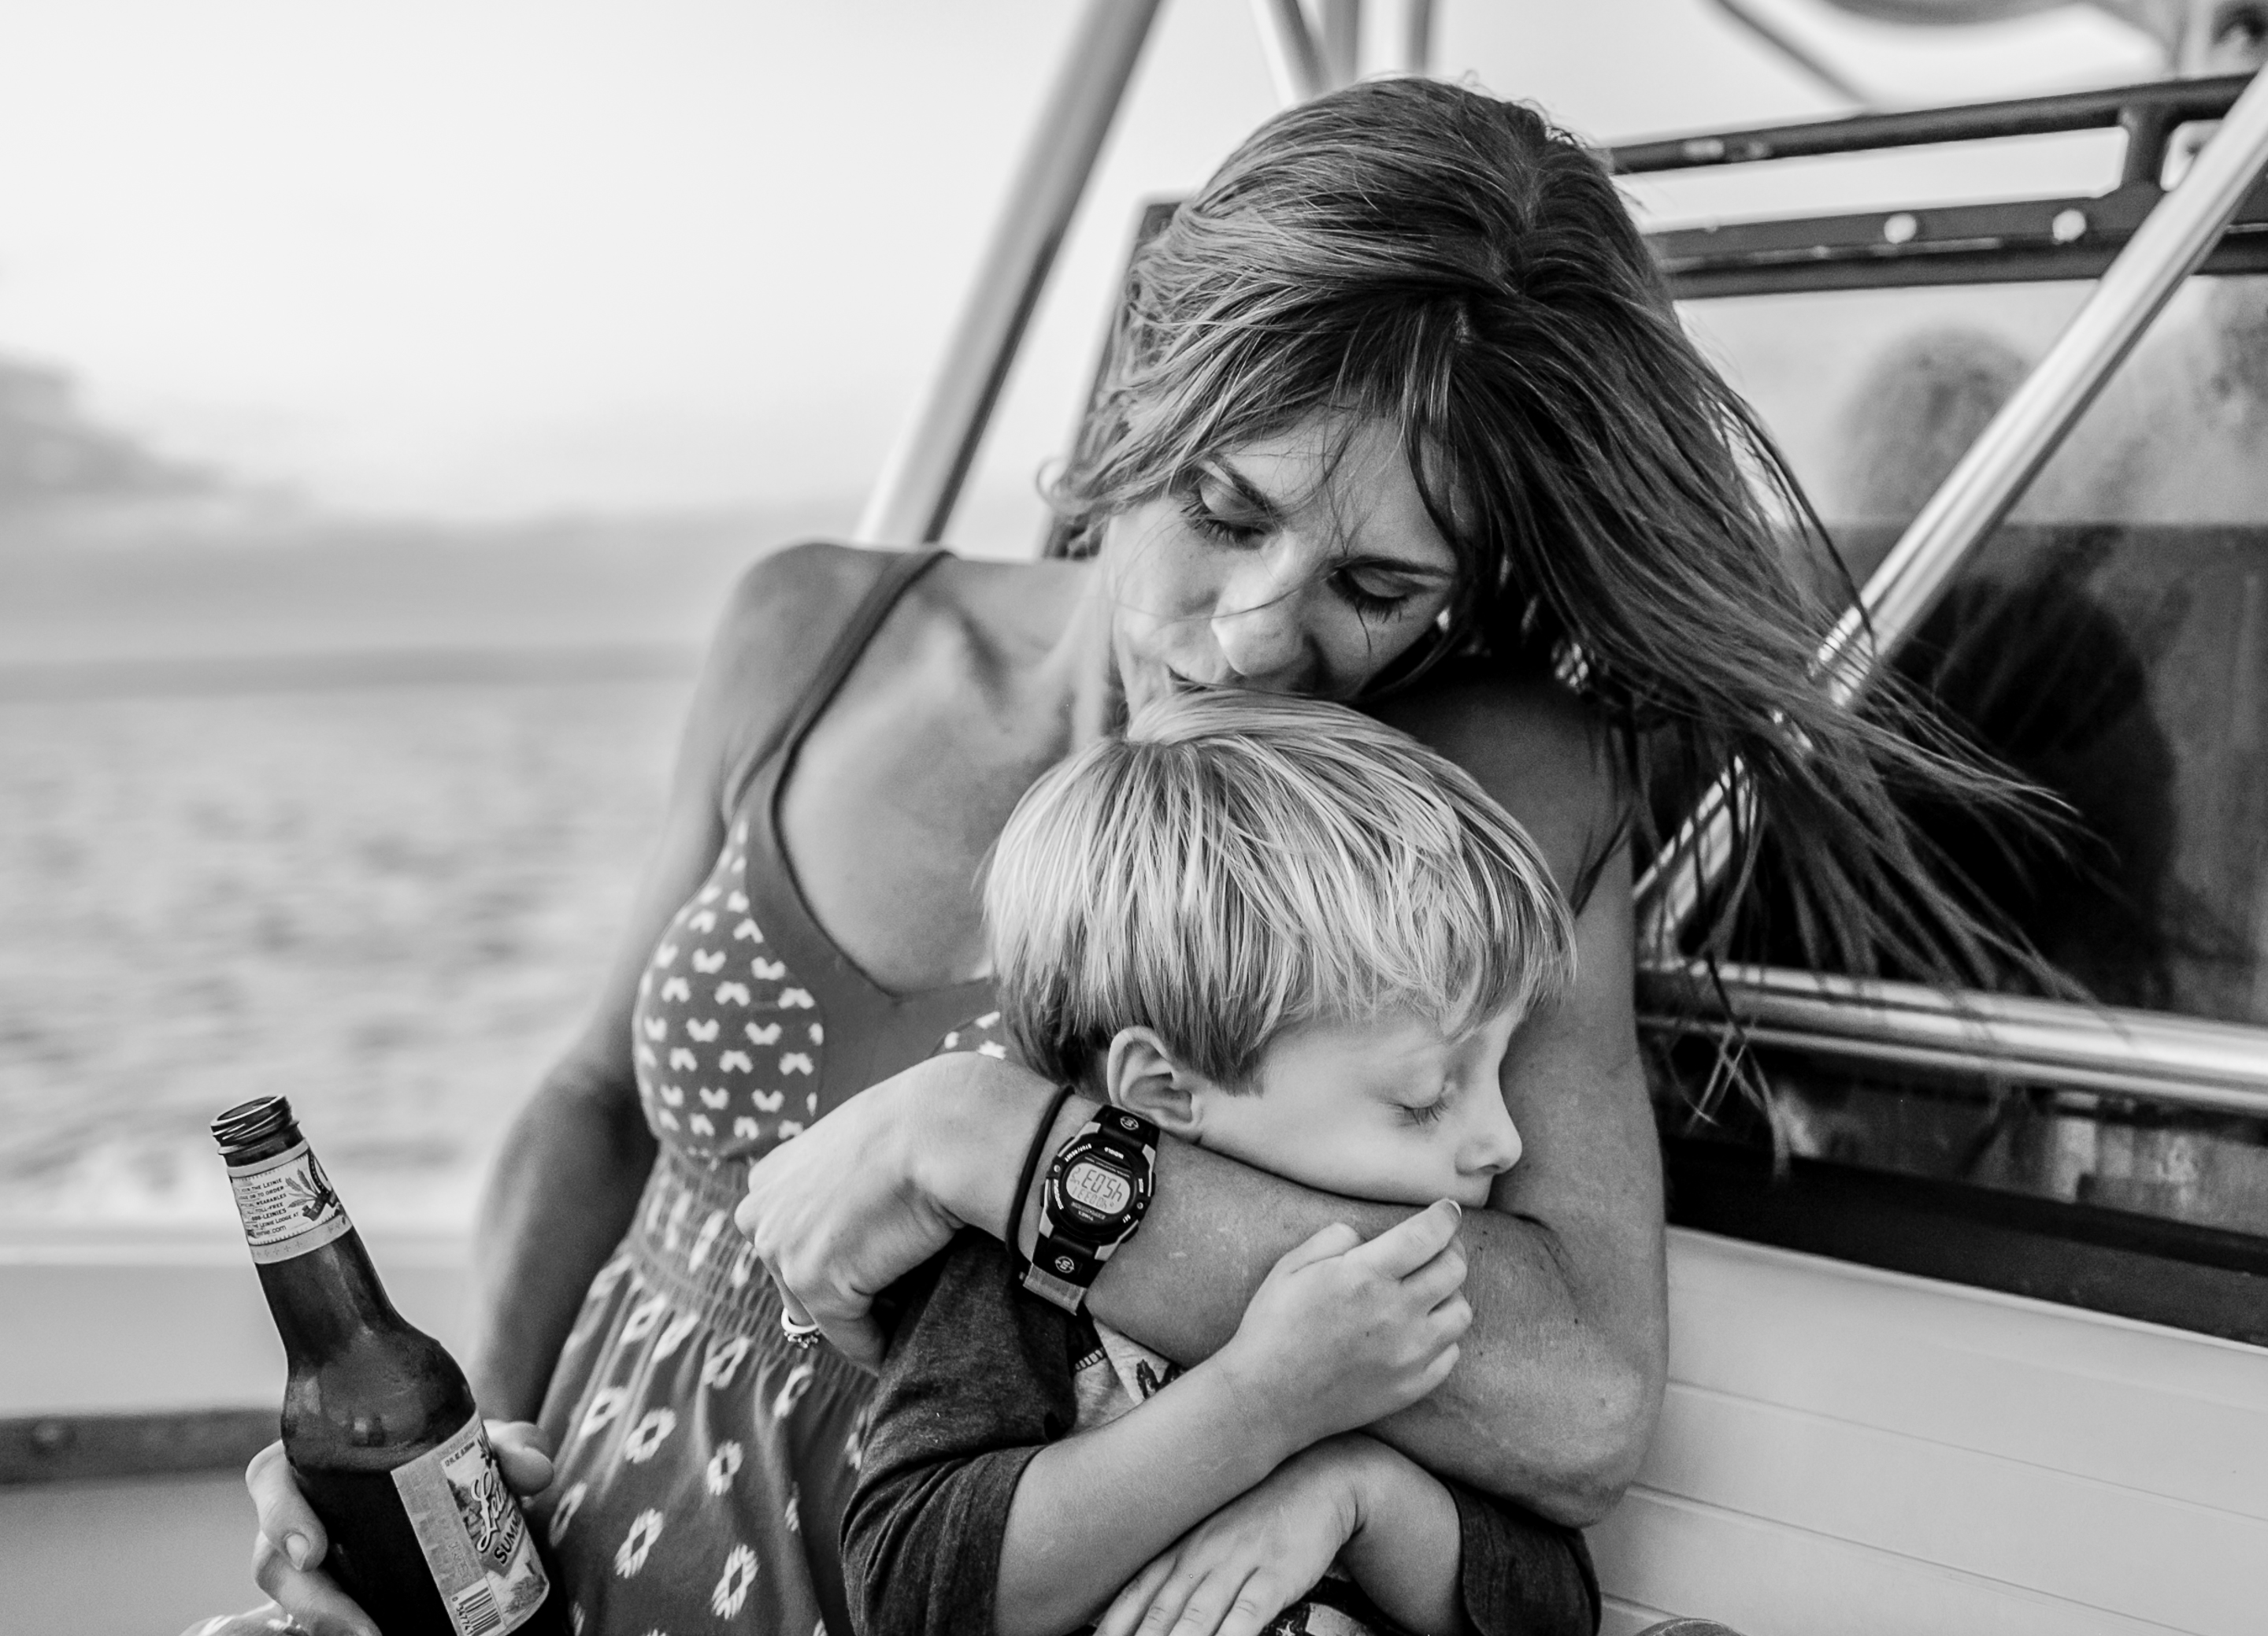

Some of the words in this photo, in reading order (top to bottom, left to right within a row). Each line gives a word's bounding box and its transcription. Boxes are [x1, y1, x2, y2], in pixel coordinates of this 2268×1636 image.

[263, 1178, 282, 1188] LEINIE
[265, 1185, 285, 1196] ORDER
[256, 1193, 287, 1207] WEARABLES
[275, 1215, 292, 1224] LODGE
